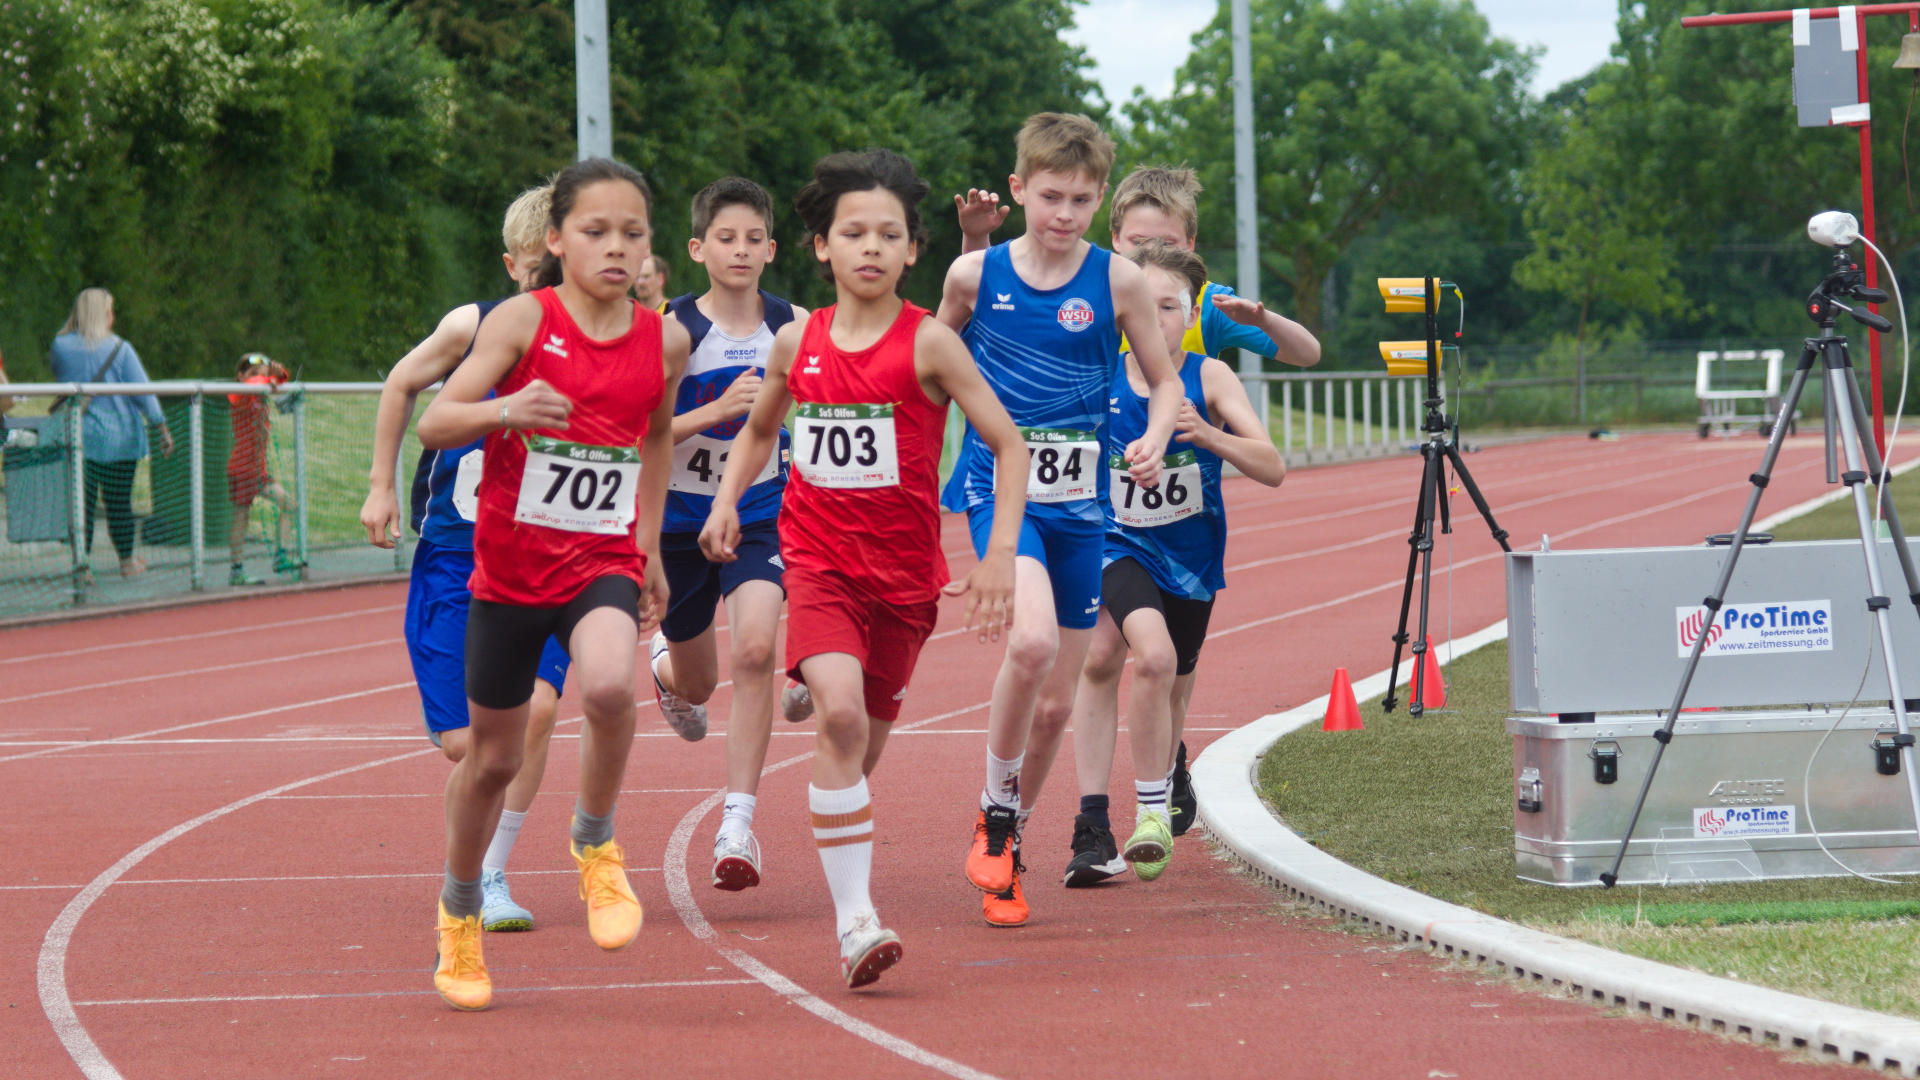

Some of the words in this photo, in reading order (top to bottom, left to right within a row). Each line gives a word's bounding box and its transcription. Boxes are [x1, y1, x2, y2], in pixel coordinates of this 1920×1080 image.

[992, 303, 1015, 311] erima
[1061, 311, 1089, 321] WSU
[808, 425, 878, 467] 703
[541, 462, 622, 511] 702
[1120, 473, 1188, 509] 786
[1724, 605, 1828, 630] ProTime
[1719, 637, 1829, 651] www.zeitmessung.de
[1726, 808, 1789, 822] ProTime
